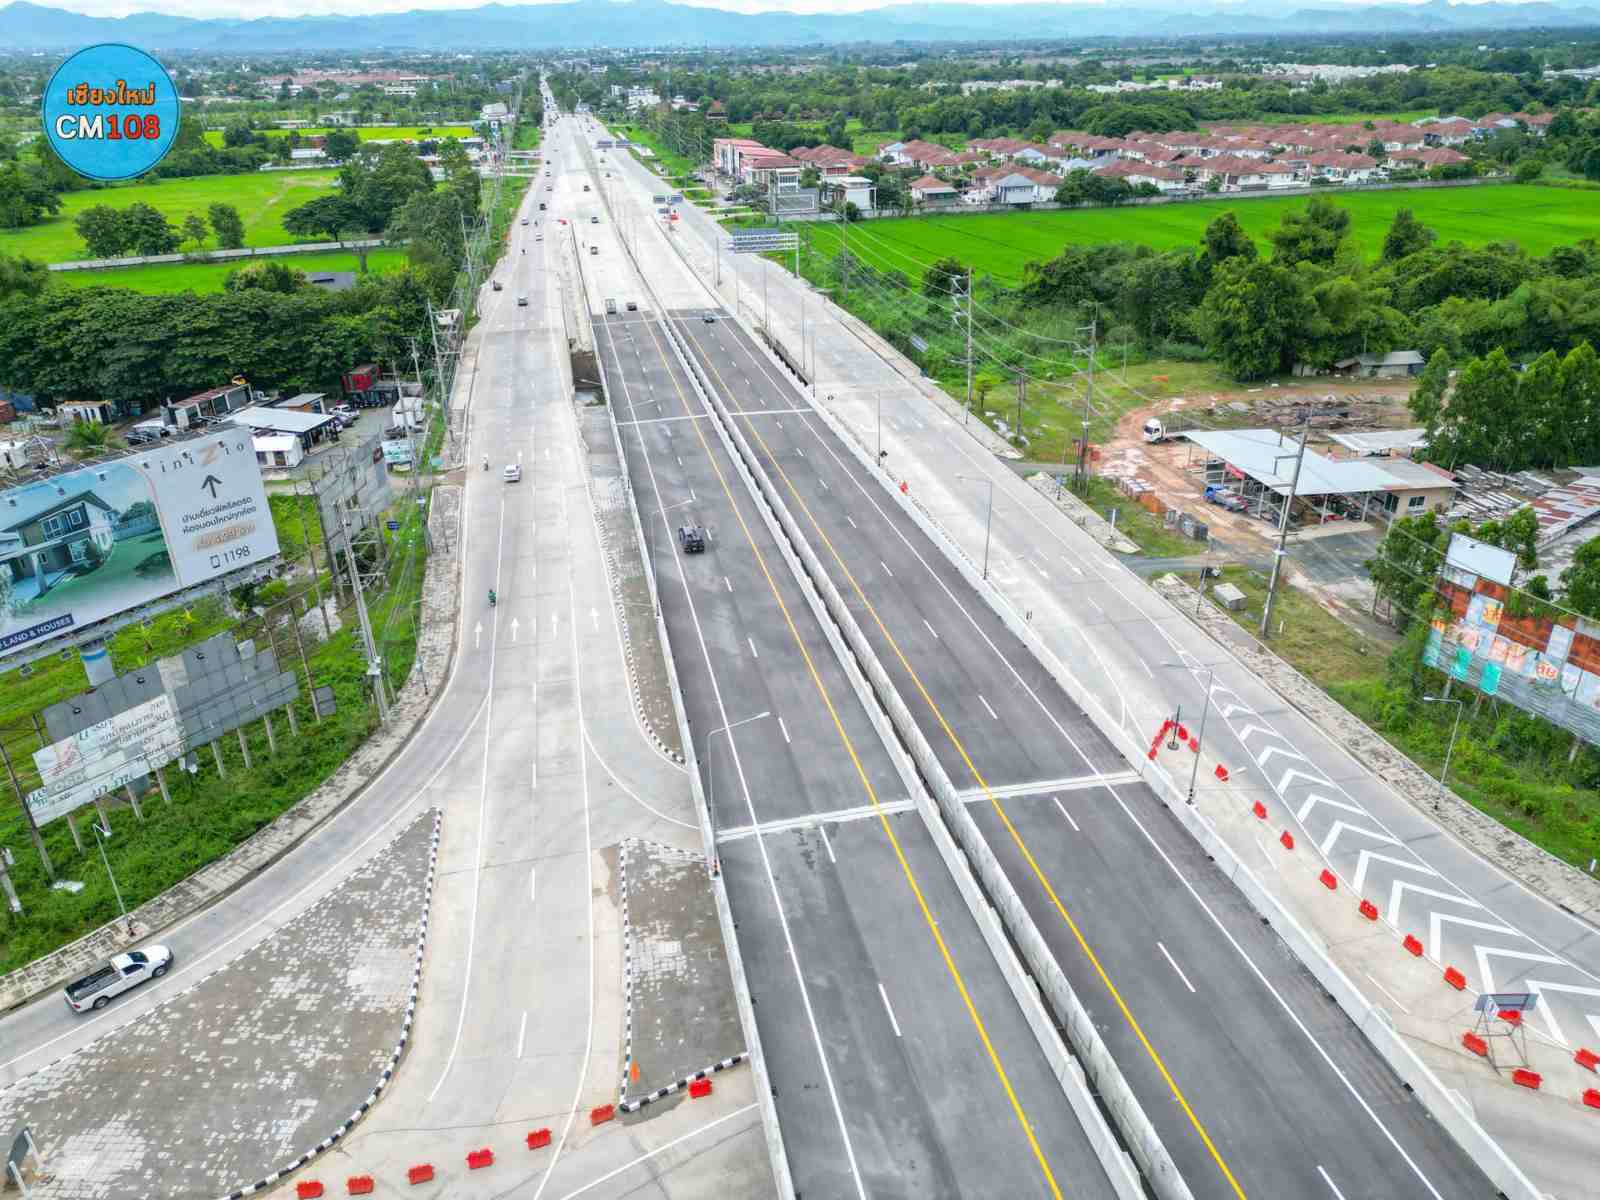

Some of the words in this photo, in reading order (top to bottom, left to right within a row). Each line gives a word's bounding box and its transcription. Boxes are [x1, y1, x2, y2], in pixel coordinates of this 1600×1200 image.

[223, 545, 250, 563] 1198
[3, 633, 28, 648] LAND
[37, 616, 72, 634] HOUSES
